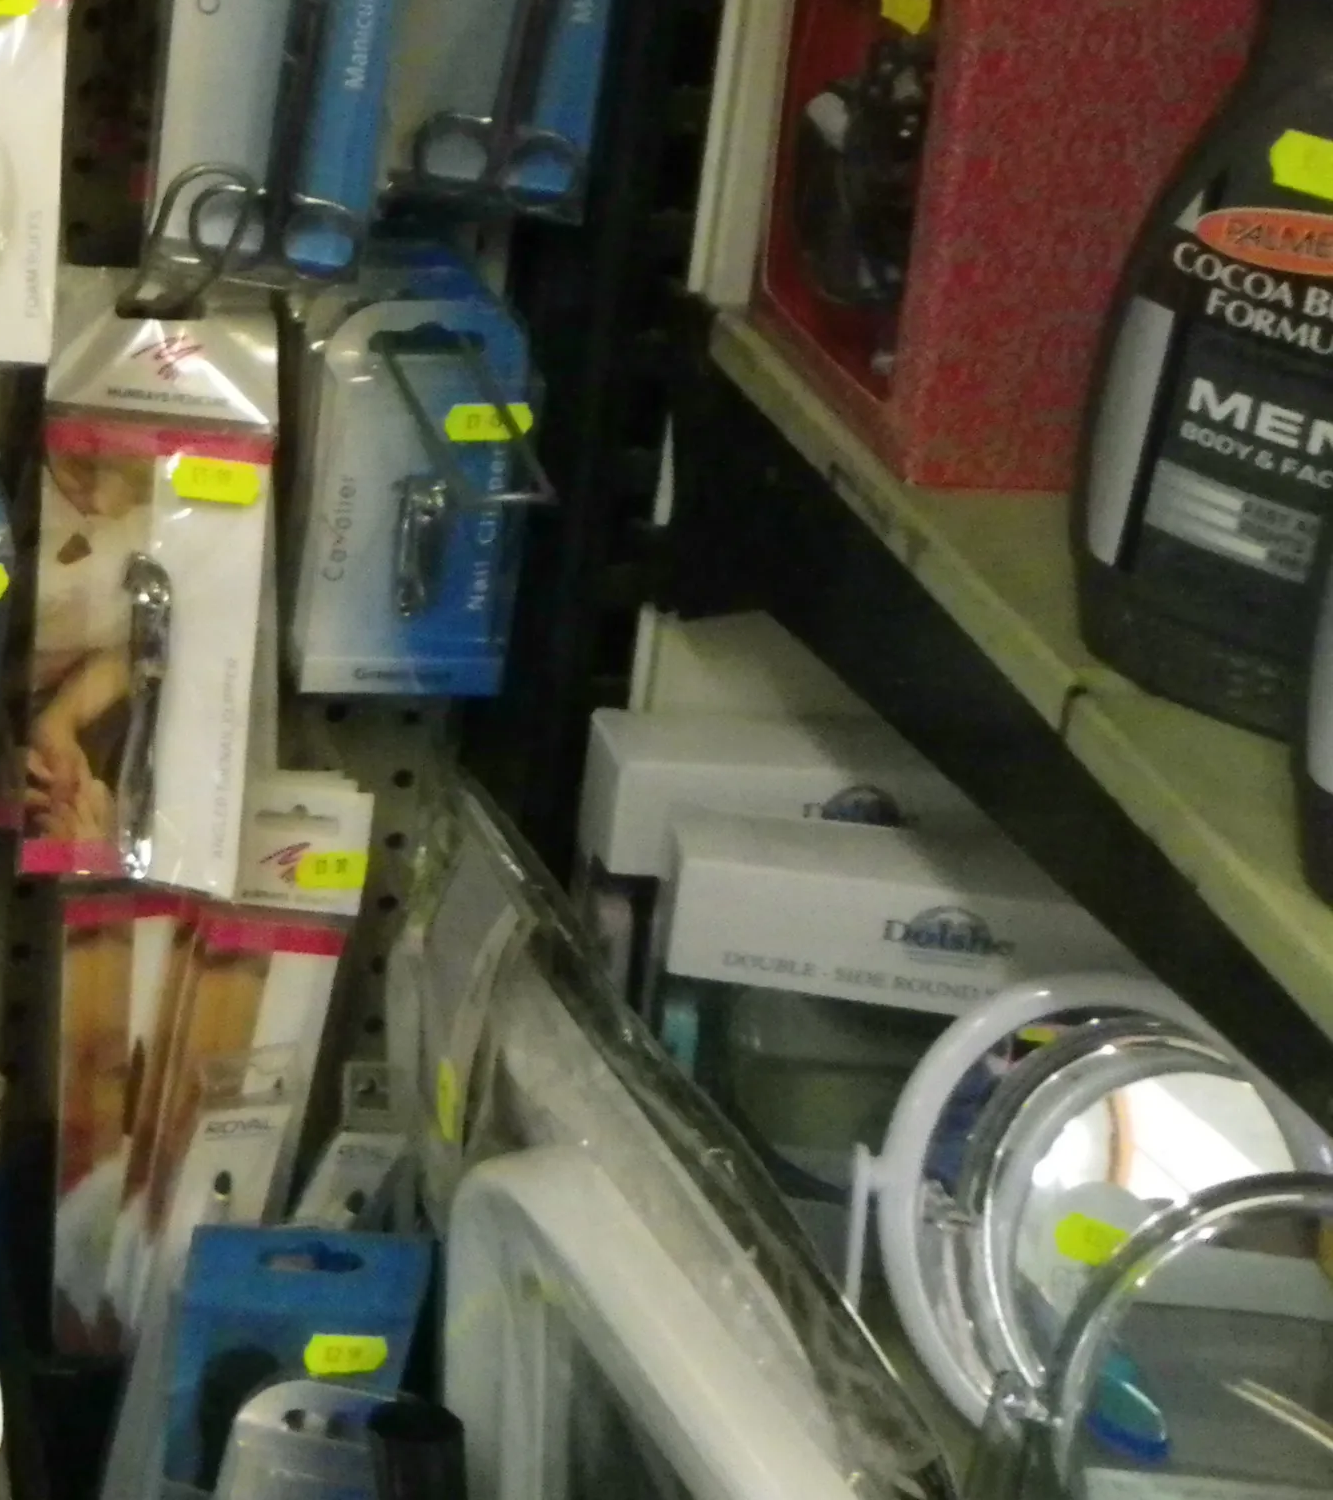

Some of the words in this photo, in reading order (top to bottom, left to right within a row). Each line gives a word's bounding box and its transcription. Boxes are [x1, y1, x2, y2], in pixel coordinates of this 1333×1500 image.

[1173, 241, 1299, 307] COCOA
[1180, 420, 1253, 467] BODY
[1254, 444, 1275, 472] &
[325, 474, 358, 583] Cavalier
[465, 562, 491, 611] Nail
